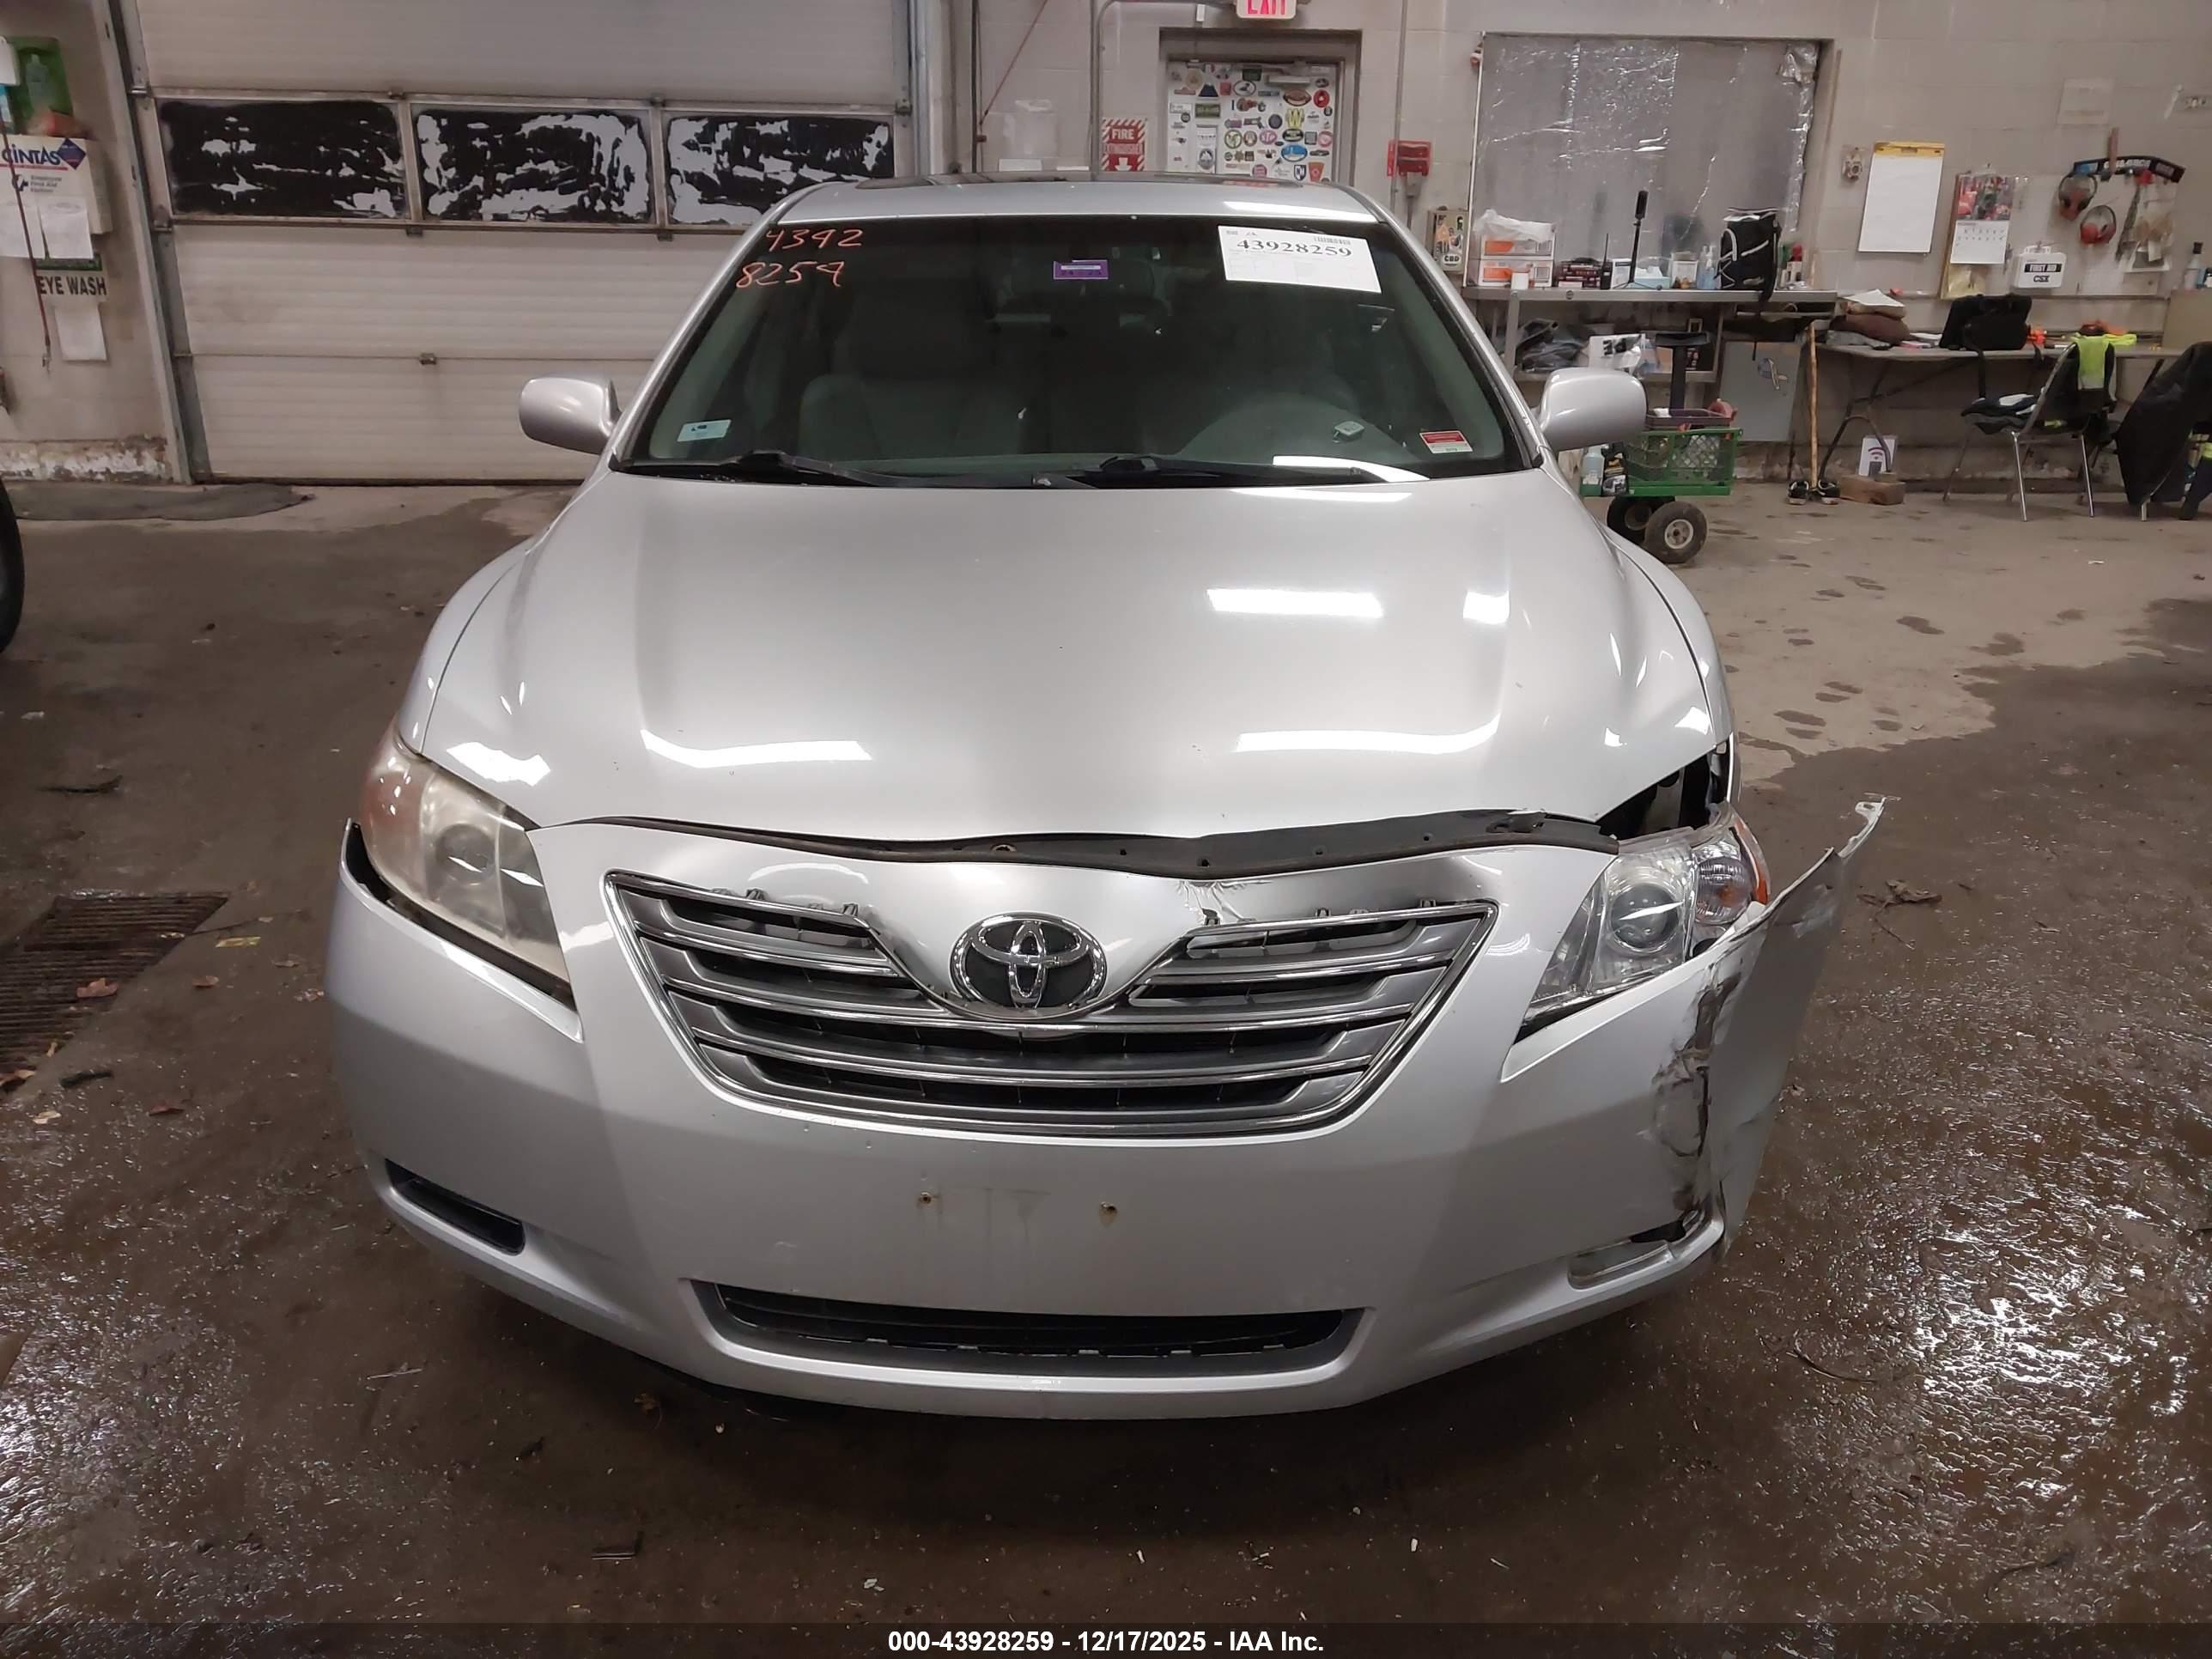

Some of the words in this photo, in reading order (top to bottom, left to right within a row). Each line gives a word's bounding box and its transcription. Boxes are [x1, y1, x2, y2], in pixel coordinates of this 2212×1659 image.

[1112, 129, 1134, 139] FIRE
[1237, 239, 1352, 258] 43928259
[736, 261, 845, 289] 8259
[36, 276, 64, 295] EYE
[66, 276, 107, 295] WASH
